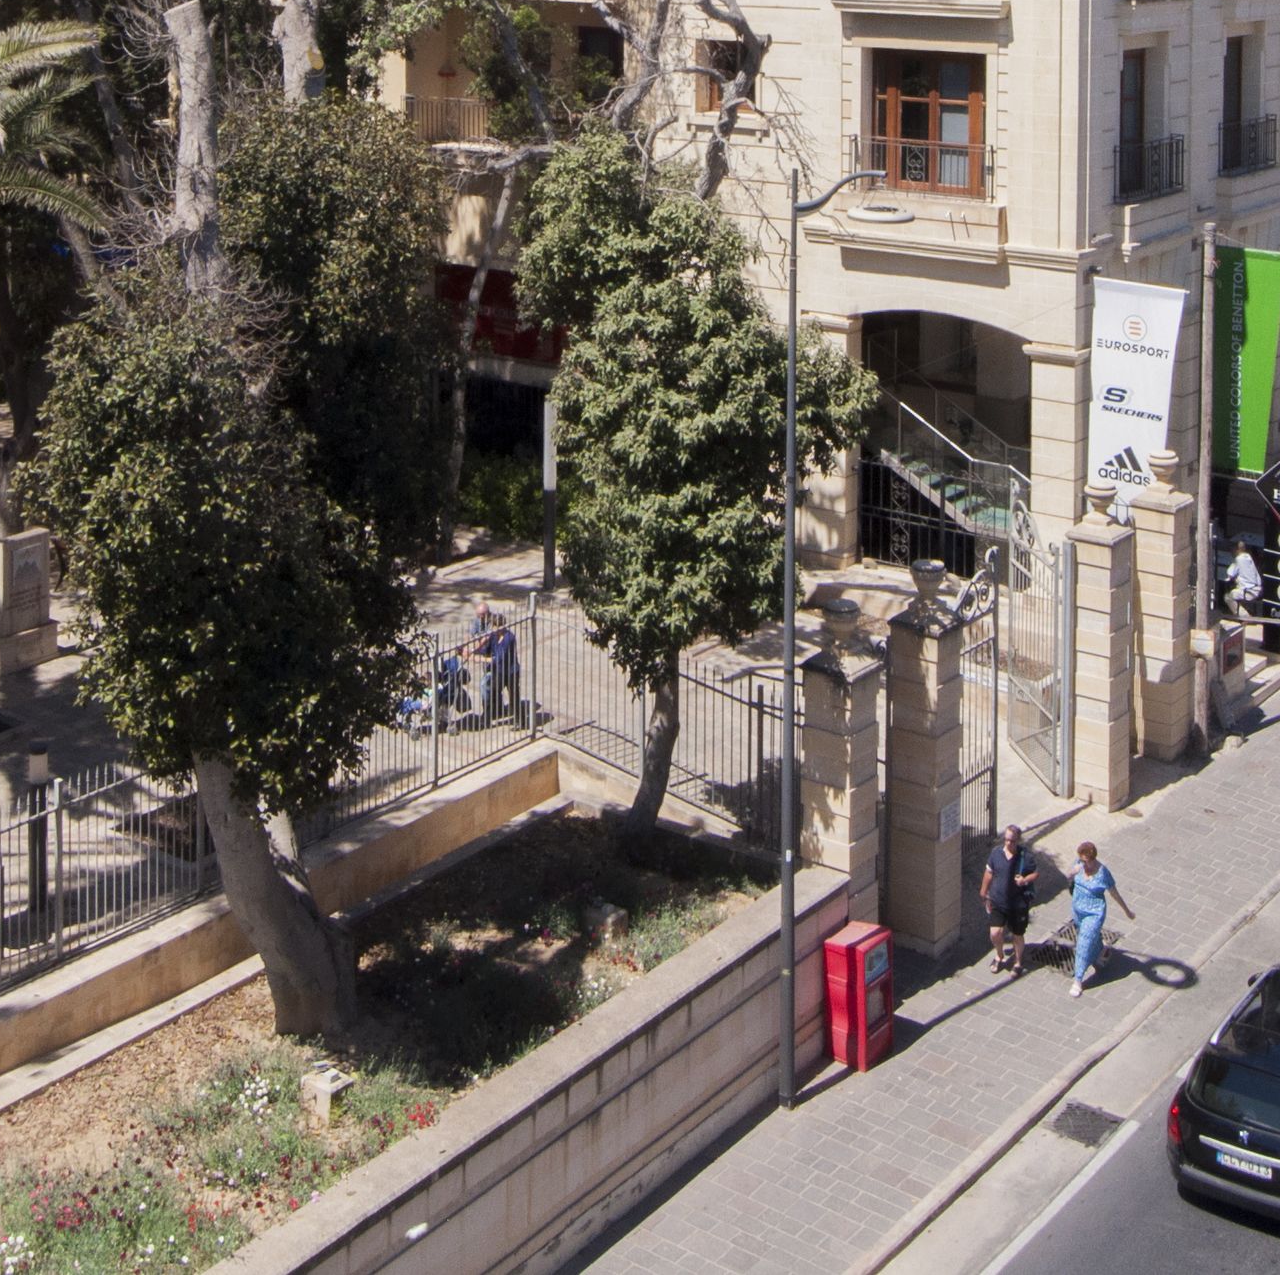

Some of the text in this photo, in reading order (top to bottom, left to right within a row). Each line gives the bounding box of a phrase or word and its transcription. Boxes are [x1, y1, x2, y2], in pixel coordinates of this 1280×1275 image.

[1096, 338, 1170, 359] EUROSPORT
[1232, 330, 1243, 355] OF
[1231, 355, 1242, 407] COLORS
[1101, 404, 1163, 422] SKECHERS
[1230, 407, 1241, 460] UNITED
[1098, 466, 1151, 486] adidas
